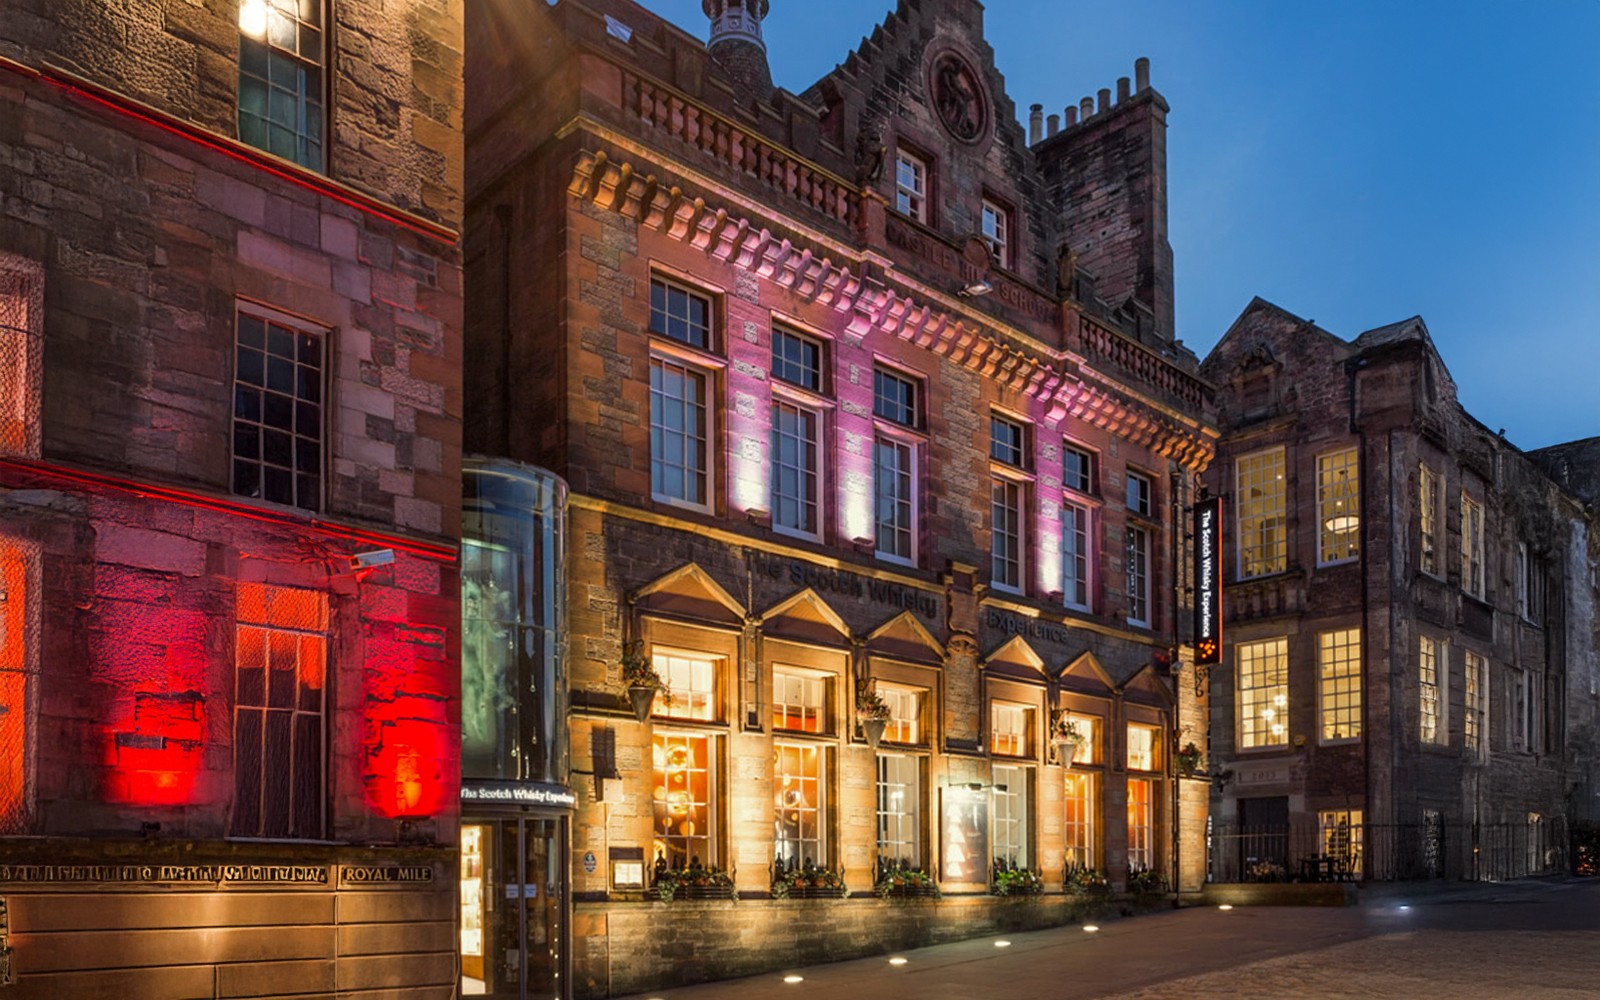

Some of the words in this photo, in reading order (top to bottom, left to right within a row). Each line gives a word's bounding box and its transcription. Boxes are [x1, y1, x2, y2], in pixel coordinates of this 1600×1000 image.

[886, 222, 953, 271] CASTLE
[1202, 510, 1212, 528] The
[1202, 528, 1212, 558] Scotch
[743, 548, 783, 579] The
[789, 562, 864, 598] Scotch
[867, 580, 937, 619] Whisky
[1201, 557, 1212, 590] Whisky
[988, 610, 1069, 641] Experience
[1201, 590, 1212, 637] Experience
[460, 787, 477, 799] The
[479, 788, 512, 799] Scotch
[513, 788, 545, 802] Whisky
[346, 868, 392, 881] ROYAL
[397, 868, 430, 881] MILE
